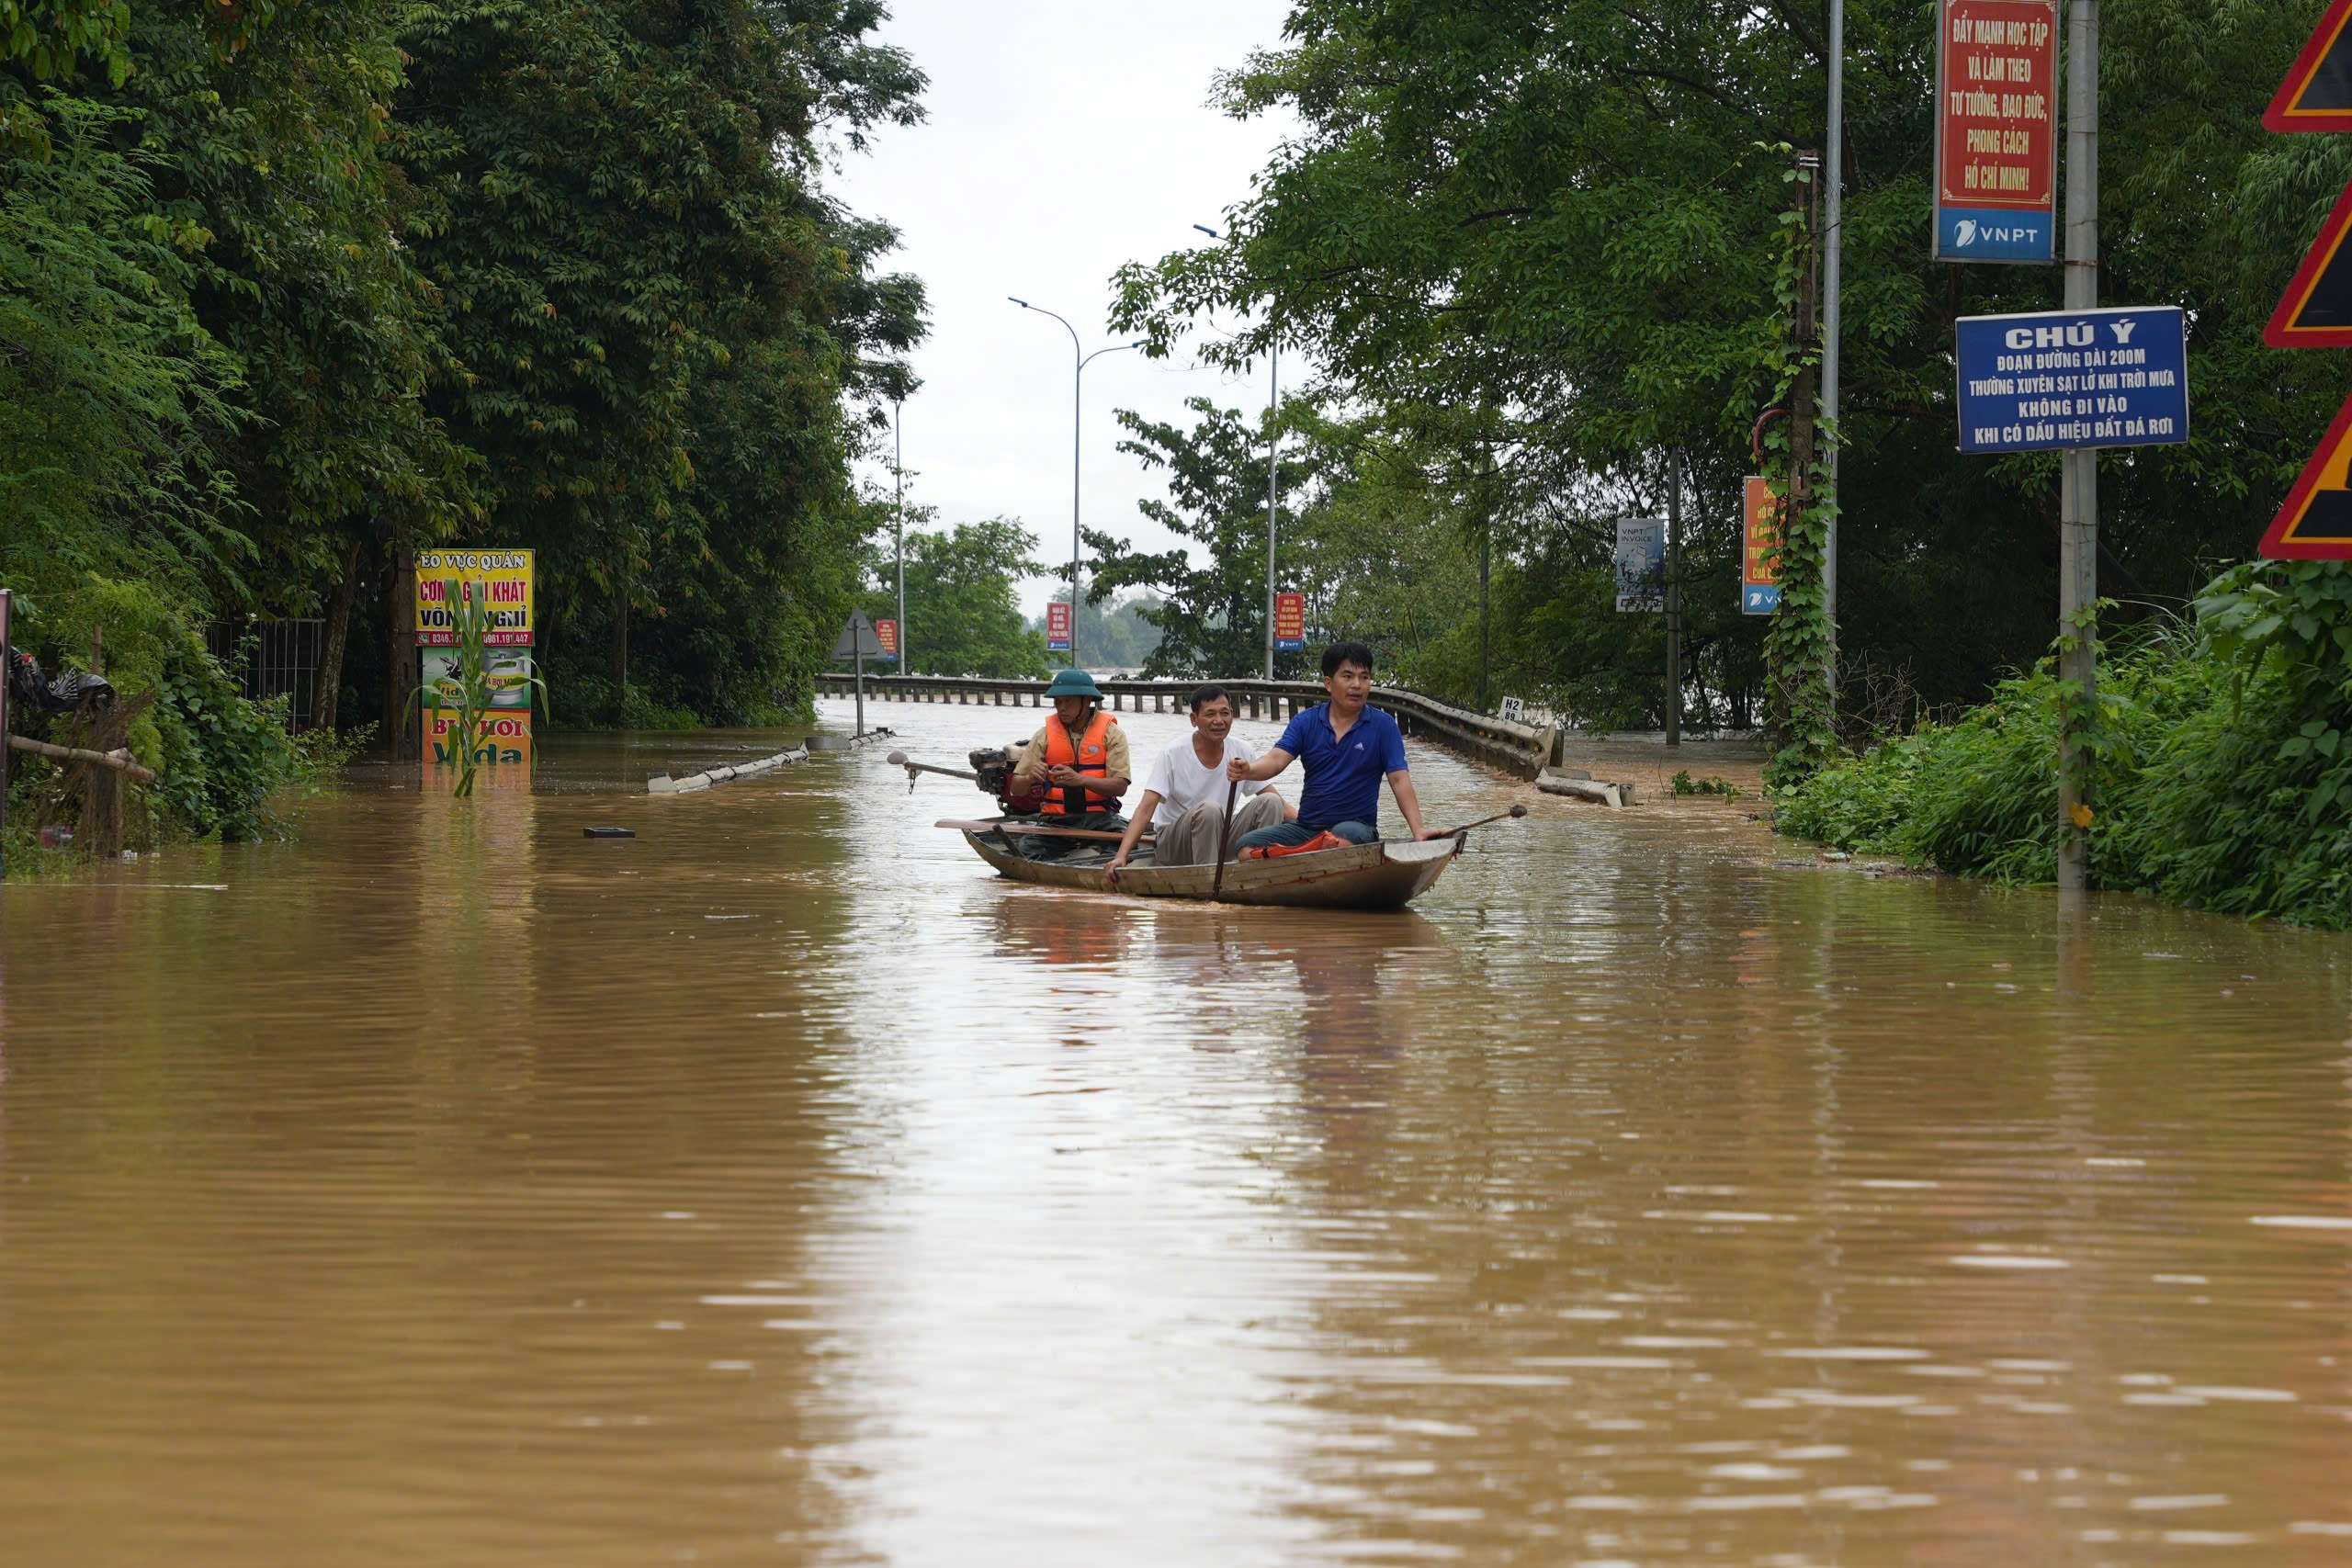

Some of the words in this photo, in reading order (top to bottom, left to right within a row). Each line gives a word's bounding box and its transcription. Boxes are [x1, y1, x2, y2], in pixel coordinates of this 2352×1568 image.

[1953, 9, 1973, 43] ĐẨY
[1975, 19, 2005, 50] MẠNH
[2007, 21, 2027, 51] HỌC
[2030, 17, 2048, 51] TẬP
[1968, 51, 1981, 80] VÀ
[1984, 52, 2005, 81] LÀM
[2007, 58, 2031, 83] THEO
[1951, 90, 1964, 116] TƯ
[1965, 85, 2000, 120] TƯỞNG,
[2002, 94, 2022, 123] ĐẠO
[2025, 90, 2047, 123] ĐỨC,
[1967, 129, 2000, 154] PHONG
[2003, 126, 2029, 154] CÁCH
[1964, 156, 1979, 189] HỒ
[1981, 161, 1997, 189] CHÍ
[1999, 166, 2029, 191] MINH!
[1980, 227, 2038, 243] VNPT
[2005, 321, 2095, 350] CHÚ
[2109, 318, 2137, 344] Ý
[1996, 354, 2033, 374] ĐOẠN
[2035, 348, 2081, 369] ĐƯỜNG
[2085, 348, 2107, 367] DÀI
[2109, 348, 2146, 366] 200M
[1969, 375, 2015, 397] THƯỜNG
[2017, 374, 2054, 394] XUYÊN
[2057, 375, 2078, 395] SẠT
[2081, 368, 2096, 391] LỞ
[2098, 373, 2118, 390] KHI
[2120, 367, 2146, 389] TRỜI
[2148, 368, 2176, 388] MƯA
[2018, 397, 2072, 418] KHÔNG
[2075, 398, 2093, 415] ĐI
[2097, 393, 2128, 413] VÀO
[1974, 427, 1999, 445] KHI
[2003, 423, 2022, 443] CÓ
[2026, 419, 2054, 442] DẤU
[2058, 420, 2091, 443] HIỆU
[2094, 414, 2122, 438] ĐẤT
[2125, 415, 2145, 436] ĐÁ
[2148, 416, 2174, 435] RƠI
[445, 552, 477, 571] VỰC
[480, 551, 526, 571] QUÁN
[492, 577, 526, 603] KHÁT
[420, 606, 454, 626] VÕN
[1505, 712, 1515, 721] 89
[1506, 699, 1520, 711] H2
[432, 742, 522, 764] Vda
